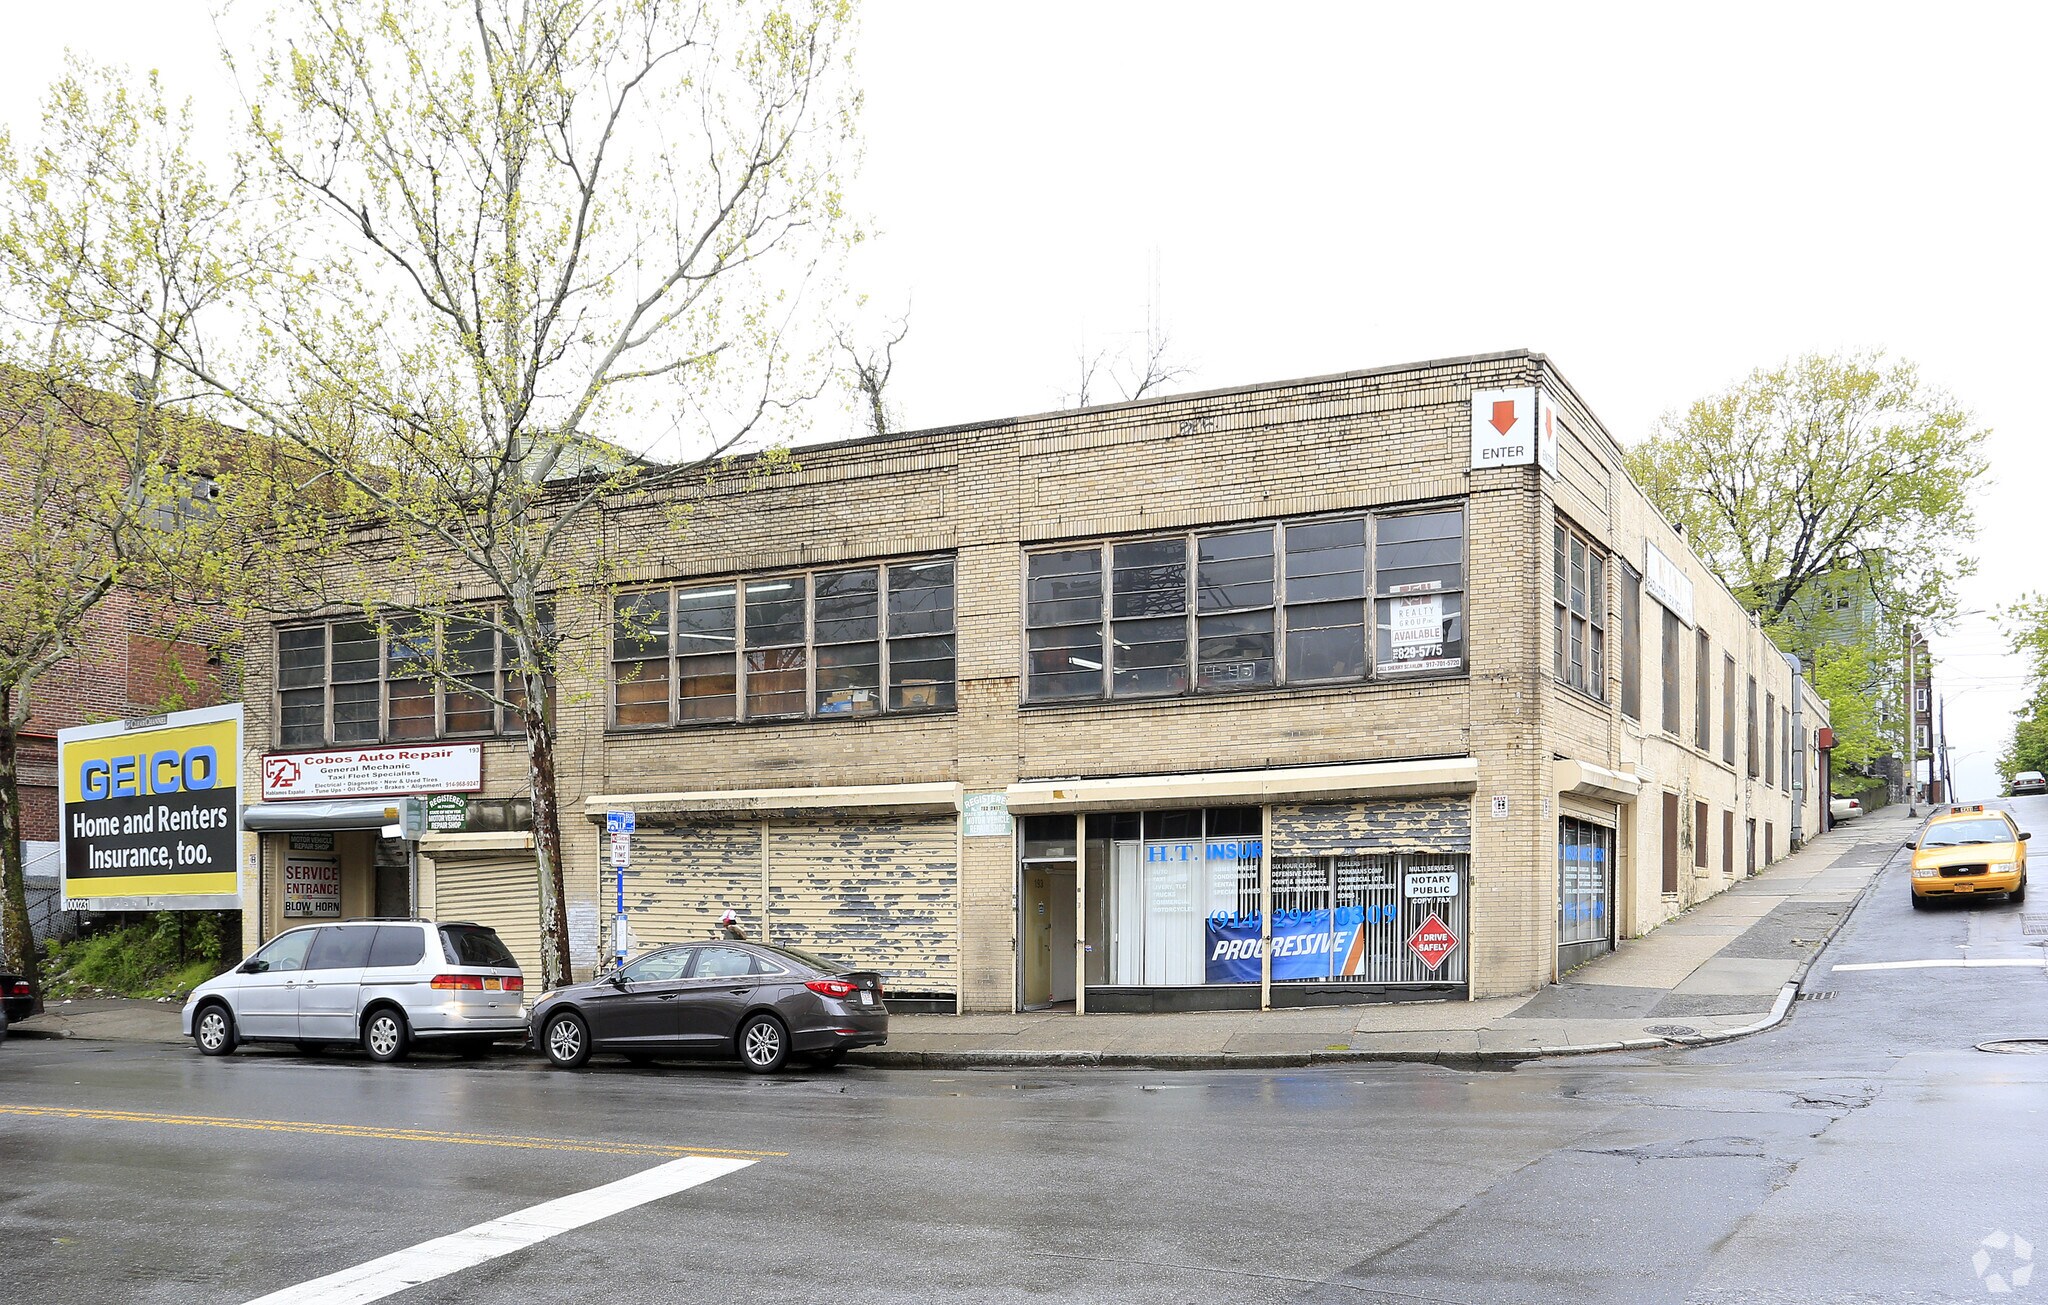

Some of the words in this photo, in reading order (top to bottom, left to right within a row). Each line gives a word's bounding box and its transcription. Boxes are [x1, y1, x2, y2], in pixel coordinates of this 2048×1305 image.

[1482, 446, 1524, 460] ENTER
[1399, 606, 1434, 617] REALTY
[1399, 618, 1427, 627] GROUP
[1394, 628, 1440, 642] AVAILABLE
[1399, 644, 1442, 660] 829-5775
[304, 756, 353, 765] Cobos
[358, 753, 395, 763] Auto
[398, 750, 454, 761] Repair
[80, 745, 218, 802] GEICO
[320, 764, 359, 774] General
[362, 762, 411, 771] Mechanic
[372, 770, 420, 778] Specialists
[348, 780, 378, 788] Diagnostic
[410, 782, 442, 790] Alignment
[429, 795, 465, 808] REGISTERED
[964, 794, 1008, 808] REGISTERE
[73, 812, 120, 839] Home
[123, 805, 154, 836] and
[158, 804, 228, 832] Renters
[445, 814, 464, 822] VEHICLE
[88, 844, 174, 870] Insurance,
[177, 840, 212, 866] too.
[1146, 845, 1199, 862] H.T.
[1283, 862, 1298, 870] HOUR
[286, 866, 338, 880] SERVICE
[1272, 870, 1301, 878] DEFENSIVE
[1302, 869, 1325, 877] COURSE
[1034, 879, 1044, 888] 193
[1296, 877, 1327, 885] INSURANCE
[1411, 876, 1452, 884] NOTARY
[286, 883, 339, 894] ENTRANCE
[1272, 886, 1304, 894] REDUCTION
[1304, 885, 1331, 893] PROGRAM
[1413, 886, 1450, 894] PUBLIC
[67, 899, 90, 911] 000231
[1412, 897, 1432, 905] COPY
[1437, 896, 1451, 904] FAX
[286, 901, 311, 911] BLOW
[315, 902, 340, 912] HORN
[1208, 908, 1262, 934] (914)
[1419, 934, 1422, 942] I
[1424, 934, 1448, 942] DRIVE
[1418, 943, 1448, 952] SAFELY
